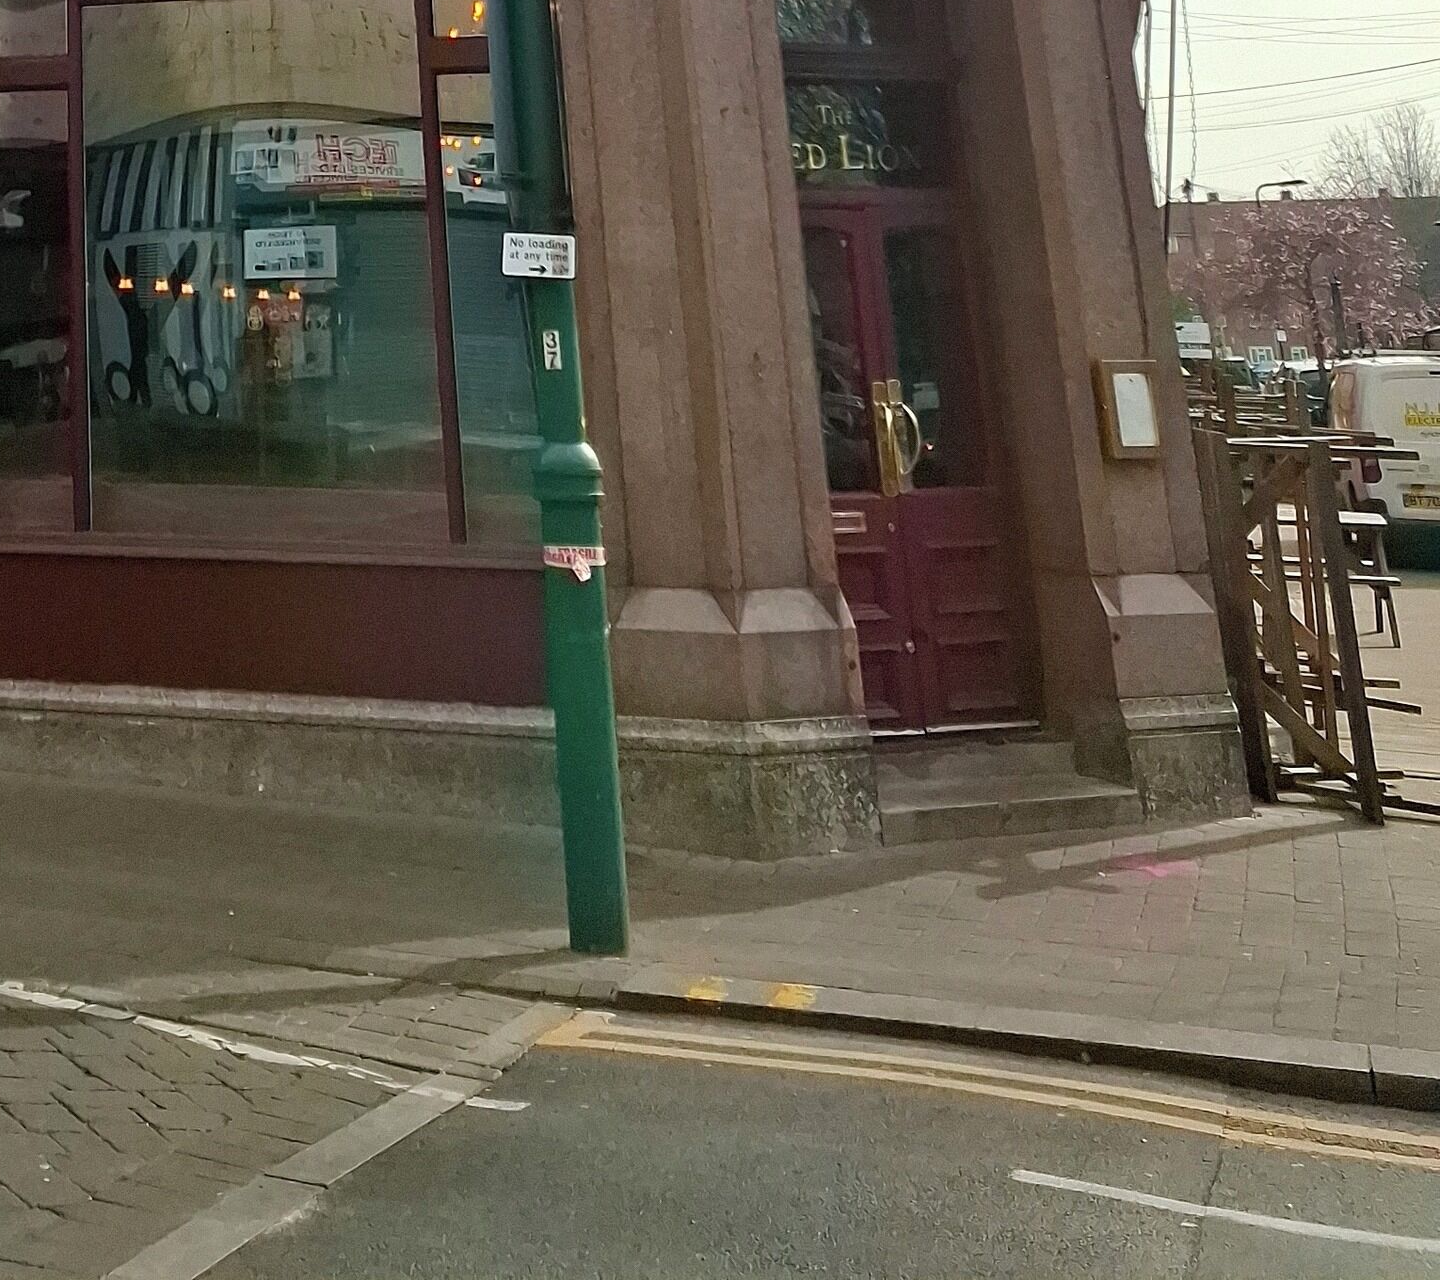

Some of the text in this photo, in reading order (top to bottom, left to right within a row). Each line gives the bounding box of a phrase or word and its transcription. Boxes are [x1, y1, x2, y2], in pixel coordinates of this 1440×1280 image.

[816, 105, 853, 125] THE
[791, 143, 826, 170] ED
[509, 237, 569, 252] No loading
[509, 250, 568, 262] at any time
